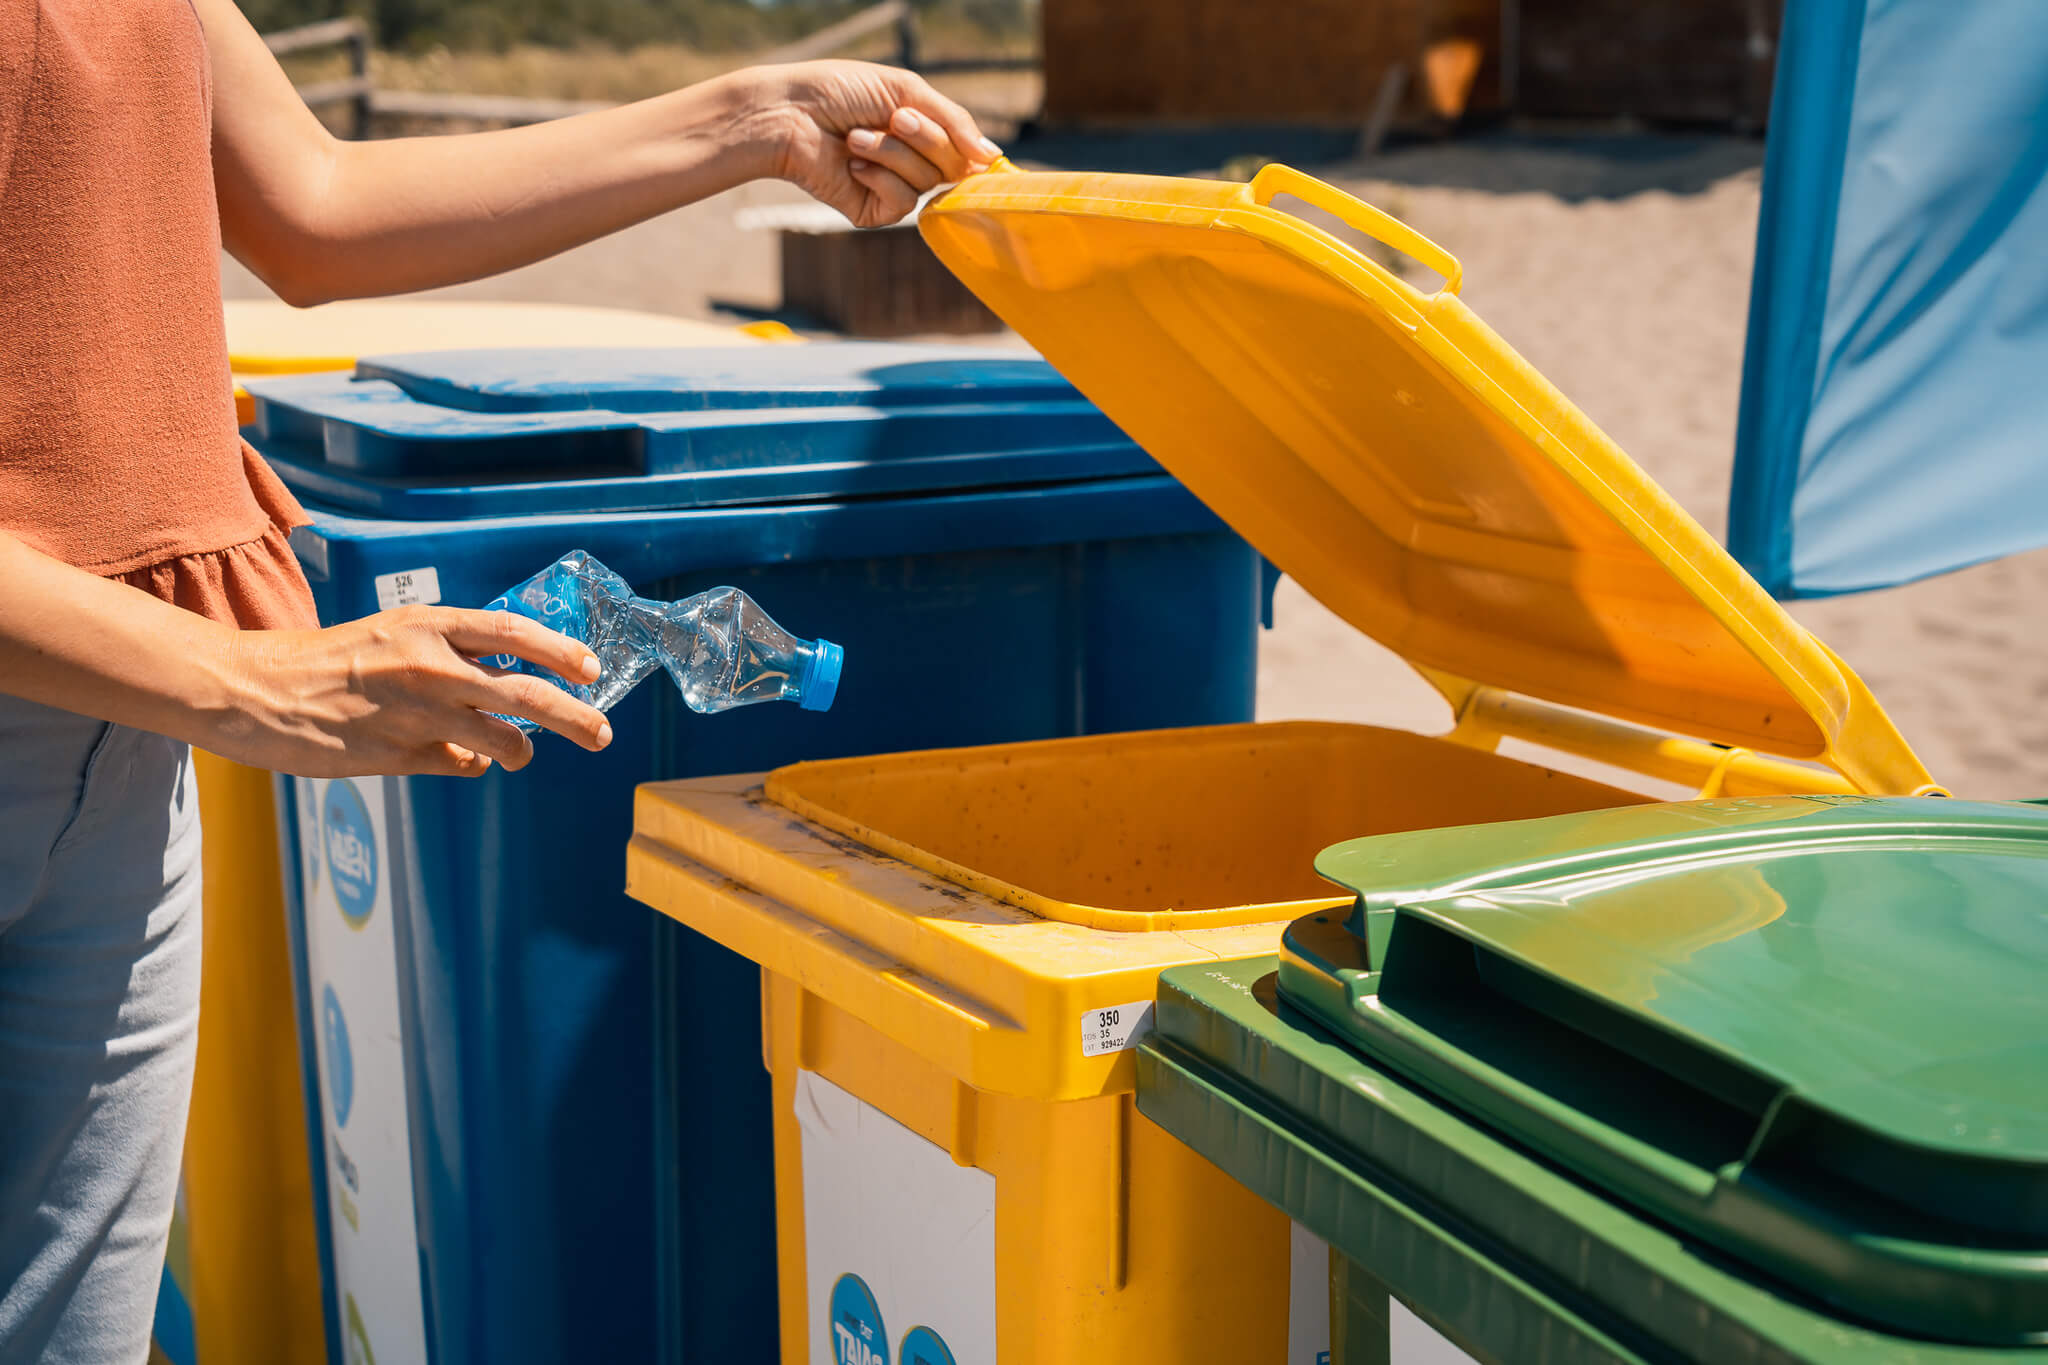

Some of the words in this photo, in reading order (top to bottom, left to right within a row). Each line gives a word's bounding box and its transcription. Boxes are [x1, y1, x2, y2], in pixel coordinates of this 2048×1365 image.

[395, 575, 413, 588] 526
[1099, 1010, 1119, 1028] 350
[1100, 1029, 1110, 1039] 35
[1101, 1038, 1124, 1049] 929422
